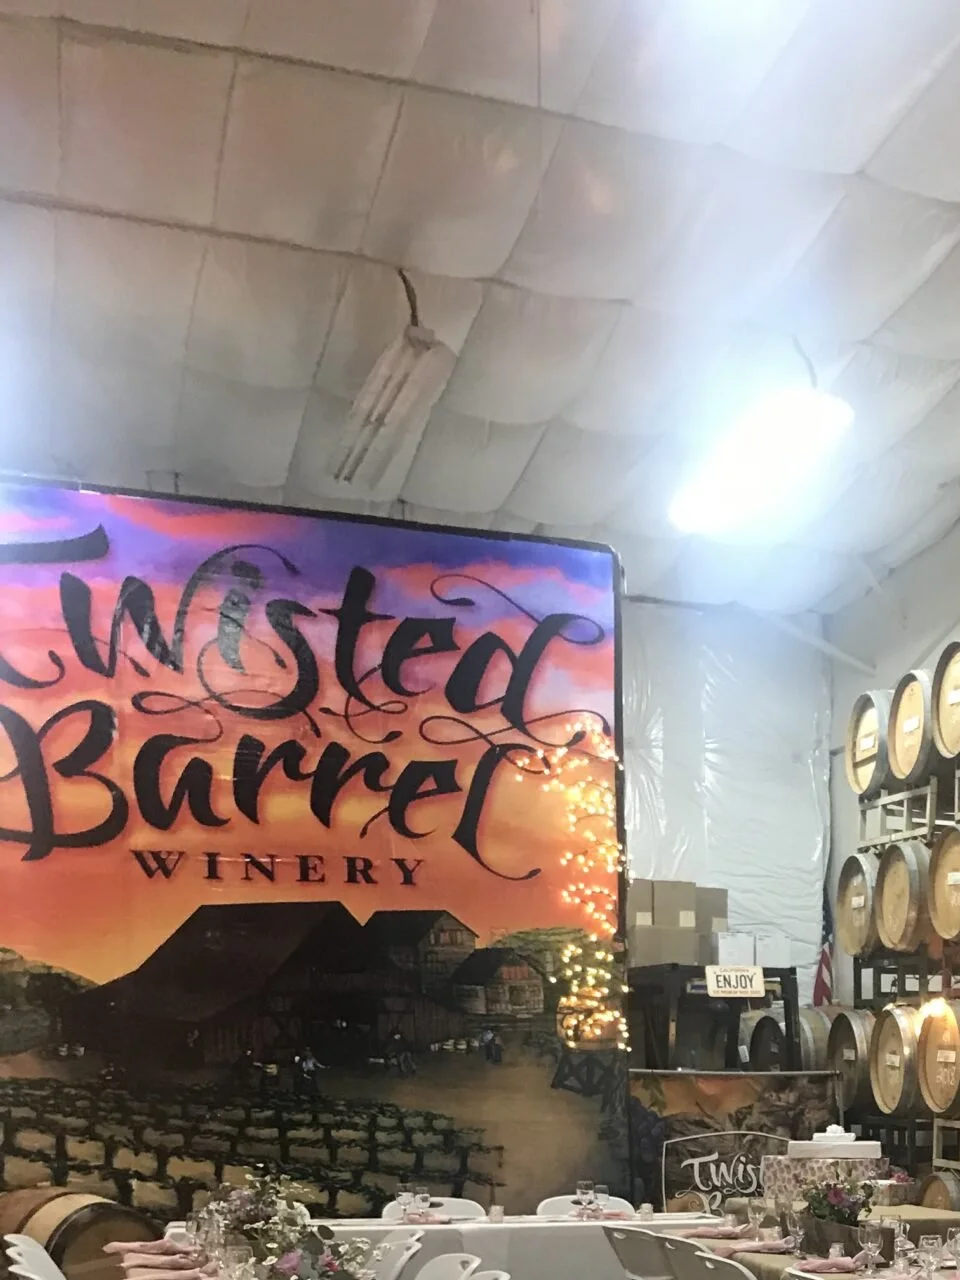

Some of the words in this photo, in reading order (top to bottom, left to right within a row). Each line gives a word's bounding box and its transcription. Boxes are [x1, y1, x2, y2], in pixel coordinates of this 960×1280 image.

[0, 699, 545, 881] Barrel
[131, 849, 426, 886] WINERY
[715, 973, 754, 989] ENJOY
